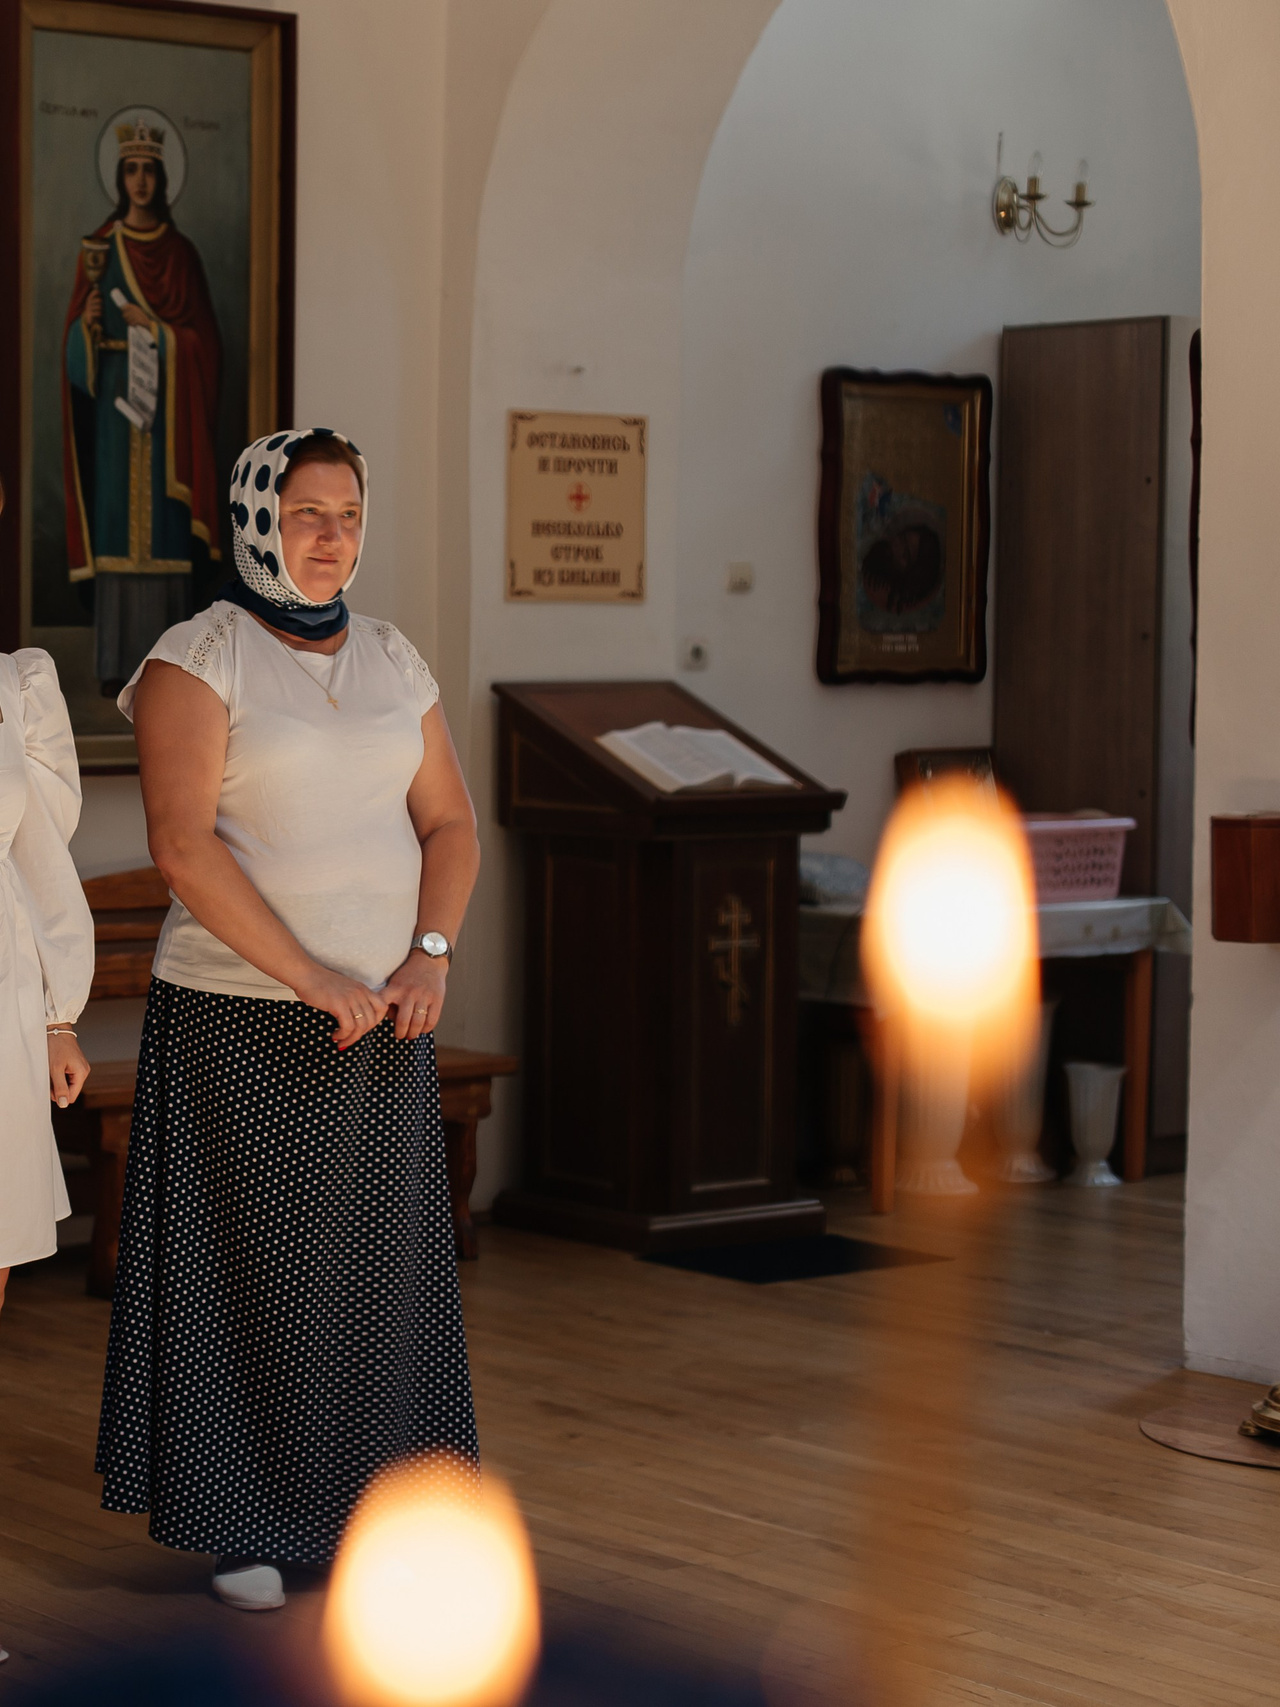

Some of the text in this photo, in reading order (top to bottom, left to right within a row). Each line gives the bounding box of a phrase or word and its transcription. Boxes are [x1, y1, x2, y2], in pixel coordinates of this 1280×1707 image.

[527, 431, 631, 452] ОСТАНОВИСЬ
[538, 456, 618, 475] И ПРОЧТИ
[531, 519, 624, 539] НЕСКОЛЬКО
[551, 545, 604, 562] СТРОК
